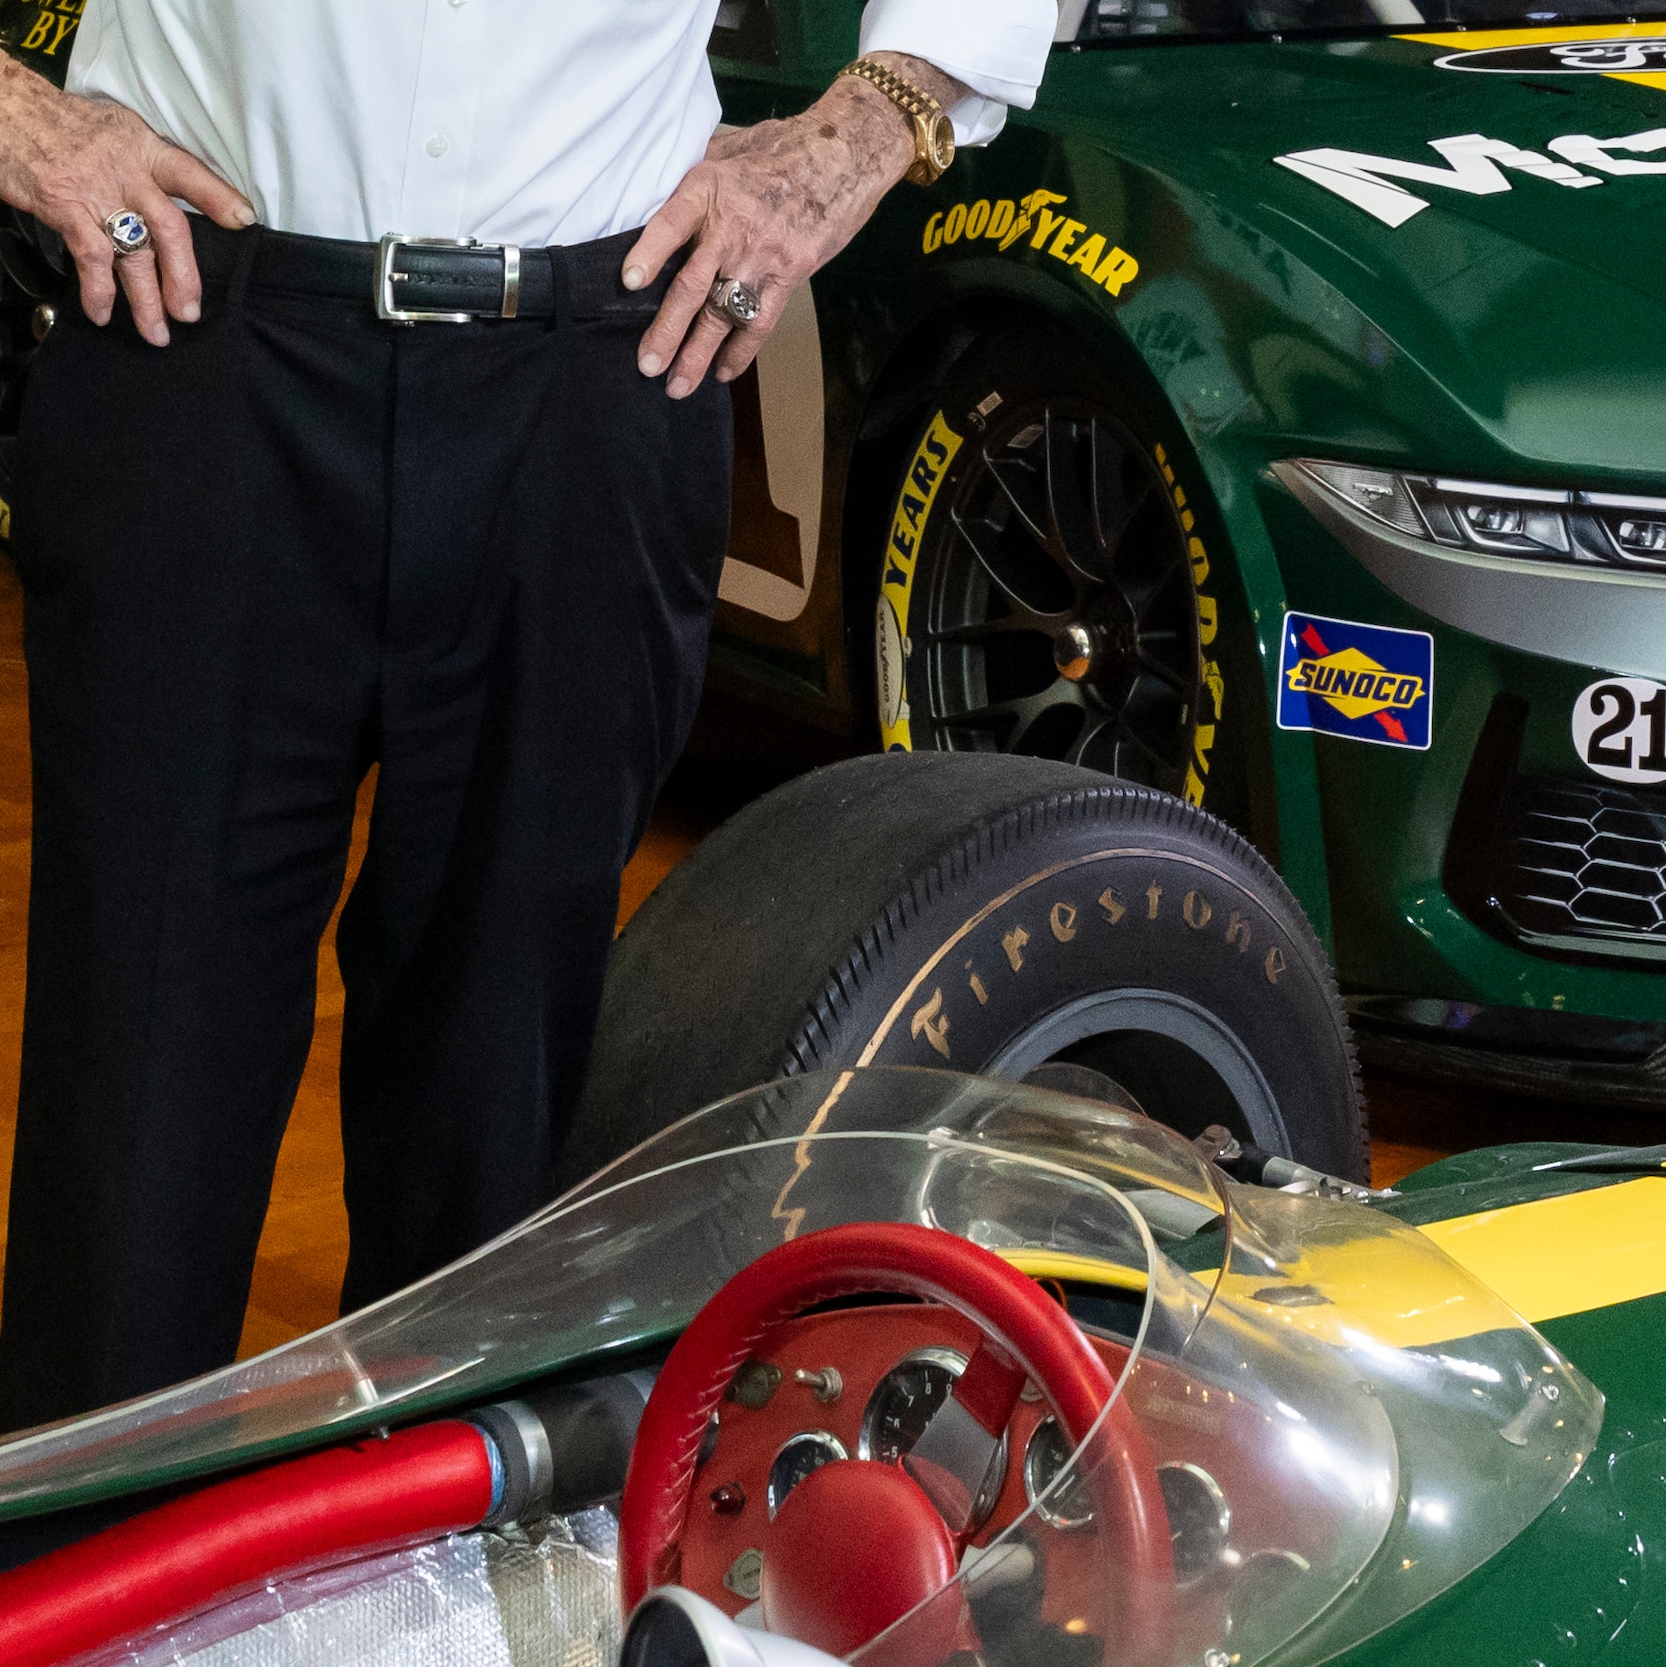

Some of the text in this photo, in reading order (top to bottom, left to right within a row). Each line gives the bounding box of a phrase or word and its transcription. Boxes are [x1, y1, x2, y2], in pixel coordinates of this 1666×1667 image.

[20, 10, 79, 56] BY
[922, 188, 1140, 298] GOODYEAR
[884, 437, 949, 589] YEARS
[1294, 662, 1418, 705] SUNOCO
[910, 879, 1288, 1060] Firestone
